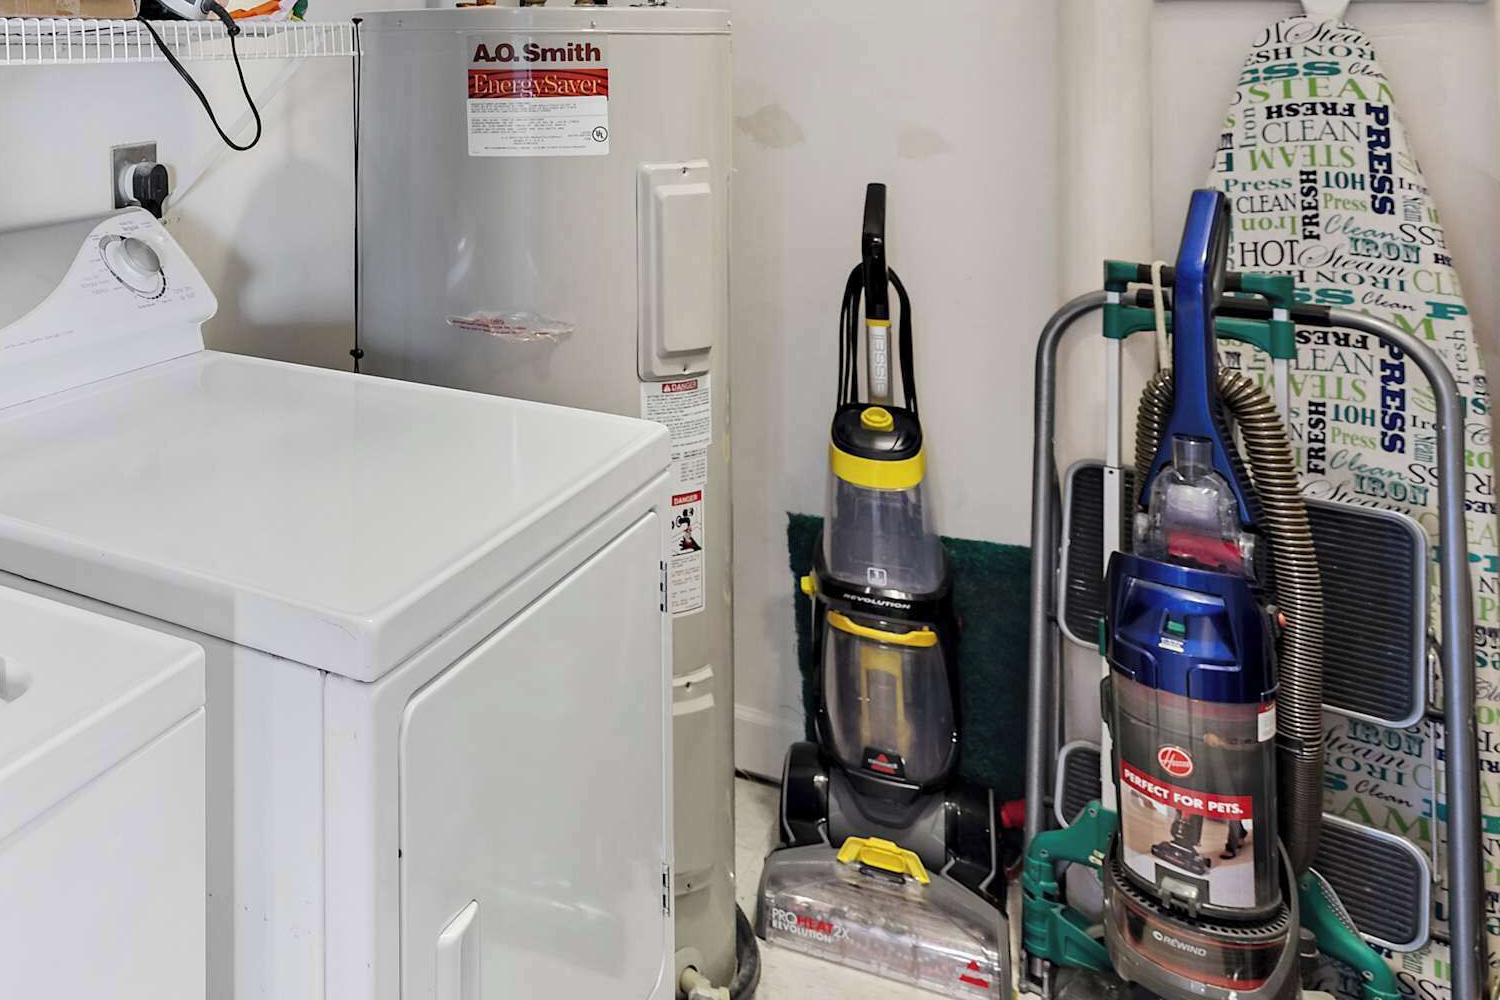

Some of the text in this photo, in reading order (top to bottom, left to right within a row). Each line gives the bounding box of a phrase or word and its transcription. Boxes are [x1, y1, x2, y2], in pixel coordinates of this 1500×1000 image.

[473, 42, 601, 62] A.O. Smith
[474, 74, 602, 98] EnergySaver
[1265, 102, 1356, 120] FRESH
[1262, 119, 1363, 144] CLEAN
[1250, 145, 1357, 171] STEAM
[1365, 102, 1396, 216] PRESS
[1224, 177, 1293, 193] Press
[1322, 171, 1366, 192] HOT
[1236, 193, 1297, 215] CLEAN
[1299, 170, 1321, 241] FRESH
[1323, 193, 1369, 213] Press
[1240, 216, 1299, 236] Iron
[1324, 214, 1399, 241] Clean
[1239, 240, 1300, 268] HOT
[1297, 244, 1407, 277] Steam
[1349, 237, 1421, 265] IRON
[1316, 271, 1406, 292] IRON
[1361, 291, 1418, 312] Clean
[1296, 330, 1369, 350] FRES
[1290, 349, 1375, 377] LEAN
[1331, 403, 1376, 427] HOT
[1307, 400, 1327, 476] FRESH
[1331, 426, 1377, 449] Press
[1329, 449, 1407, 481] Clean
[1354, 473, 1429, 507] IRON
[843, 593, 911, 610] REVOLUTION
[1348, 719, 1425, 758] IRON
[1124, 768, 1243, 814] PERFECT FOR PETS.
[1354, 780, 1413, 808] Clean
[772, 920, 832, 944] REVOLUTION
